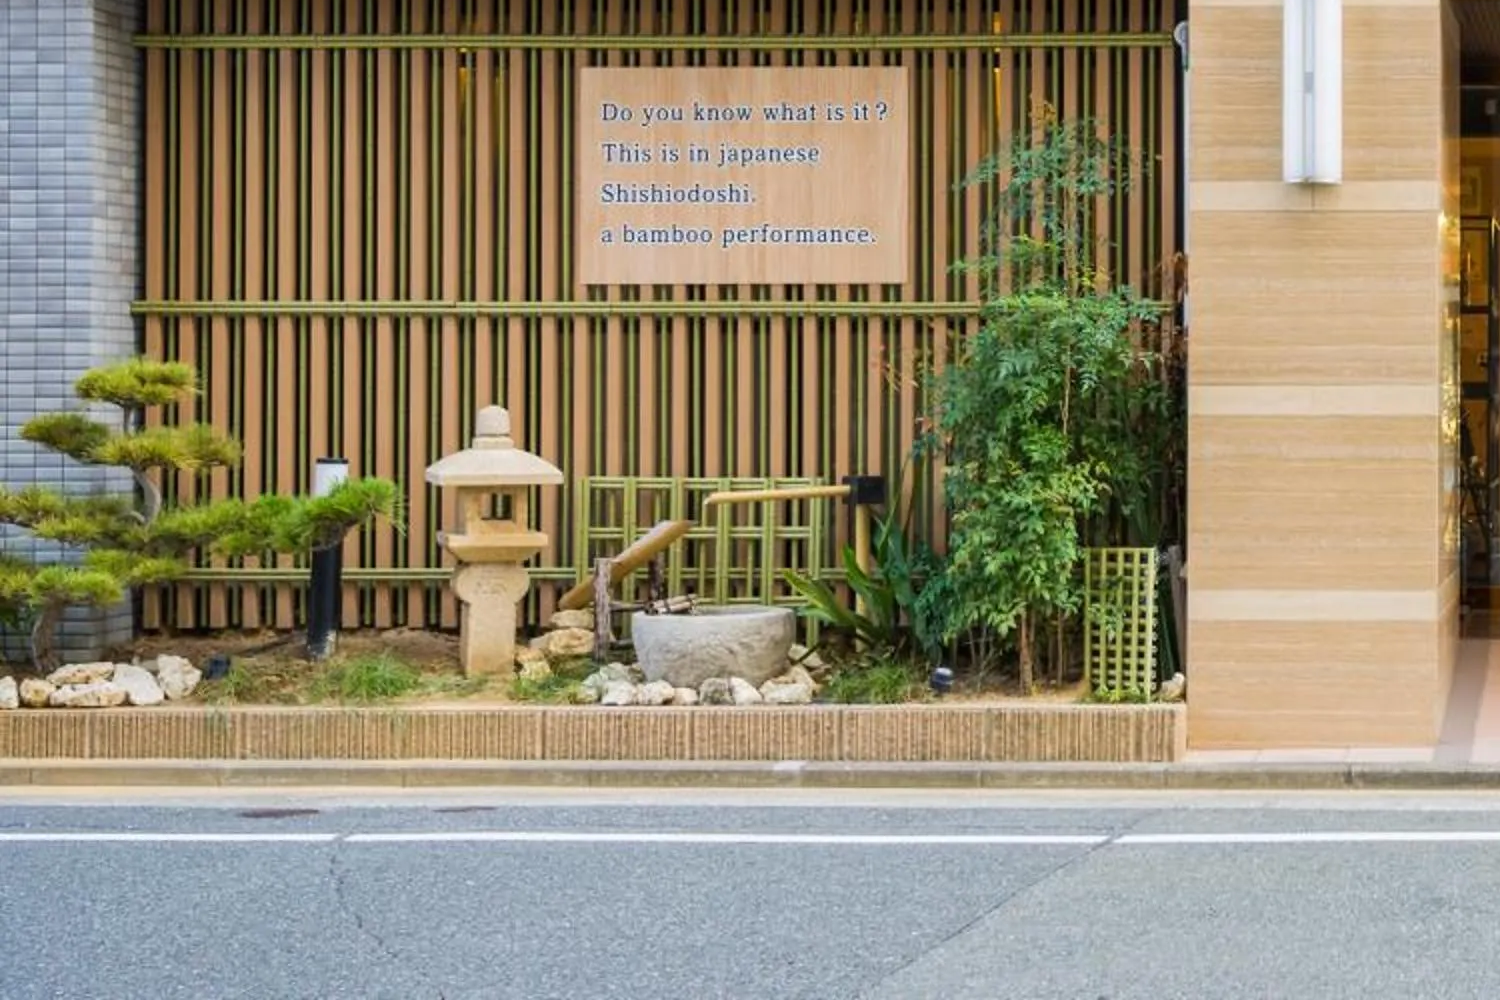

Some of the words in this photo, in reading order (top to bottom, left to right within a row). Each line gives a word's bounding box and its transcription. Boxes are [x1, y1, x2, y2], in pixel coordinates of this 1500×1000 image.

[602, 103, 632, 121] Do
[642, 105, 684, 126] you
[693, 103, 752, 121] know
[763, 103, 816, 121] what
[826, 103, 845, 121] is
[602, 144, 651, 162] This
[662, 144, 679, 162] is
[690, 144, 709, 162] in
[718, 144, 820, 167] japanese
[602, 184, 756, 203] Shishiodoshi.
[602, 229, 613, 243] a
[623, 225, 713, 243] bamboo
[722, 224, 876, 248] performance.
